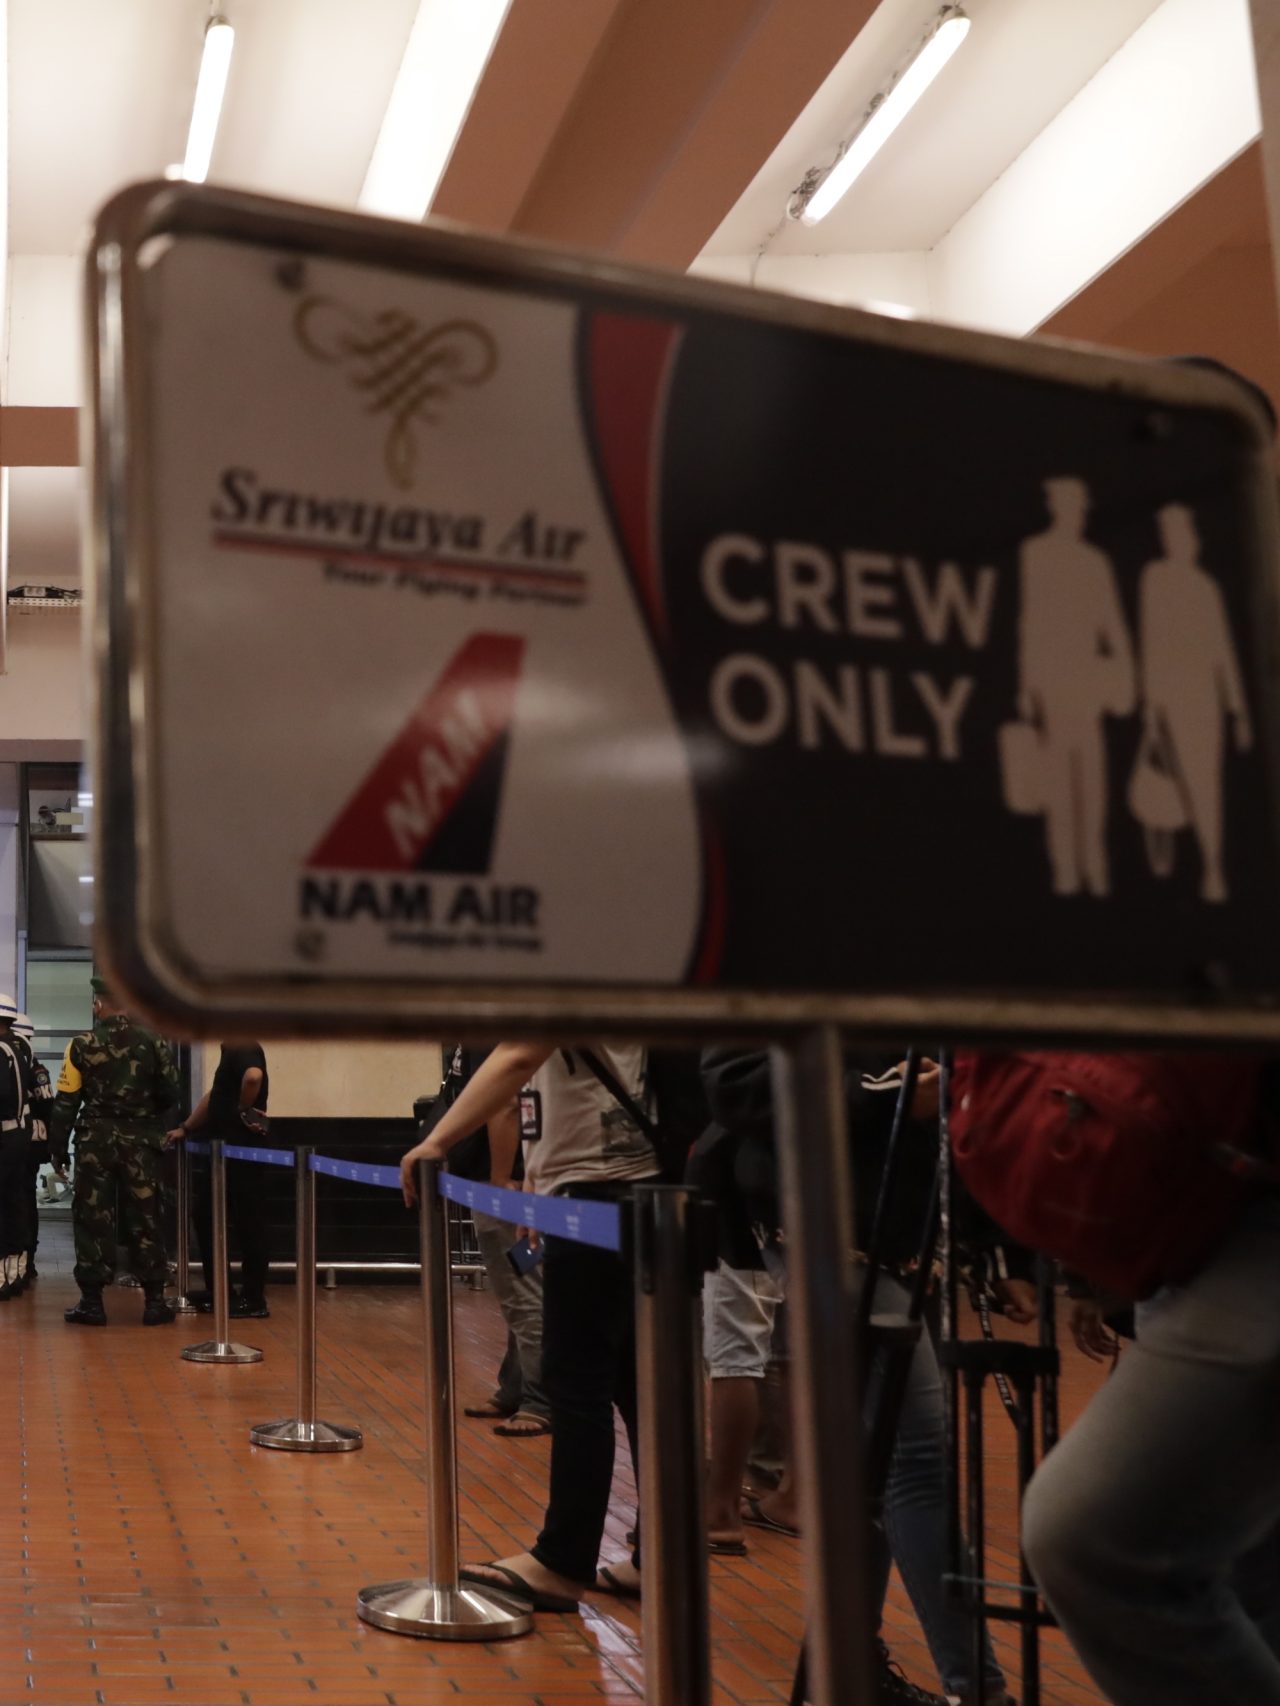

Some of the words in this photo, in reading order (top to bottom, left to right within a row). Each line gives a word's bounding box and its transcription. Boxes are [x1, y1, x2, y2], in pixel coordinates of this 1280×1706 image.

[212, 465, 485, 554] Sriwijaya
[497, 511, 588, 563] Air
[700, 533, 999, 649] CREW
[710, 653, 975, 761] ONLY
[385, 690, 488, 858] NAM
[300, 877, 432, 923] NAM
[448, 885, 539, 927] AIR
